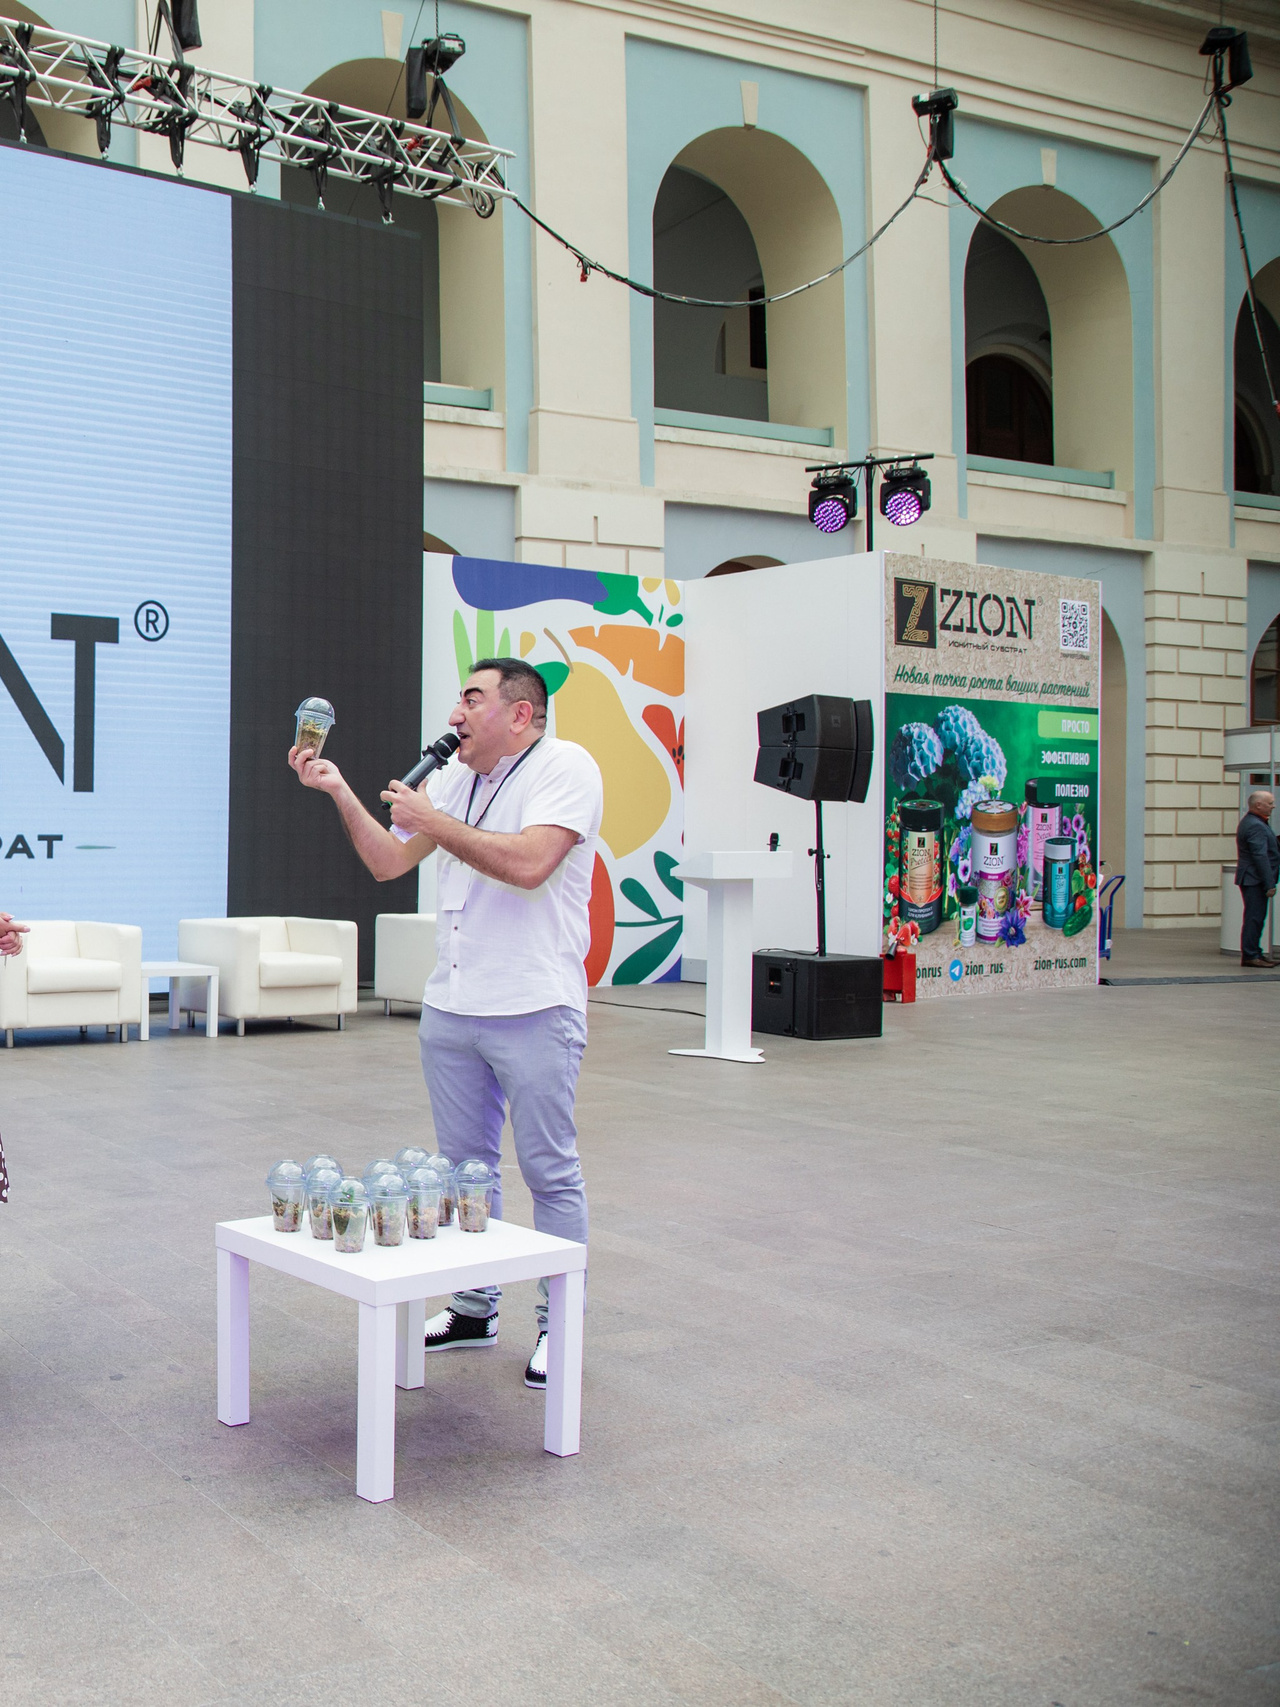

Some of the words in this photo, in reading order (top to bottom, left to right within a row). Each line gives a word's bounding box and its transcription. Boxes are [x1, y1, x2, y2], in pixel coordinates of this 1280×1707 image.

[939, 587, 1036, 640] ZION
[893, 663, 930, 684] Новая
[932, 671, 967, 688] точка
[967, 675, 1003, 693] роста
[1005, 675, 1039, 696] ваших
[1039, 682, 1091, 699] растений
[1061, 719, 1090, 734] ПРОСТО
[1041, 750, 1090, 767] ЭФФЕКТИВНО
[1055, 783, 1090, 798] ПОЛЕЗНО
[912, 848, 931, 857] ZION
[983, 856, 1004, 867] ZION
[916, 966, 942, 979] onrus
[965, 961, 1004, 977] zion_rus
[1034, 956, 1087, 971] zion-rus.com
